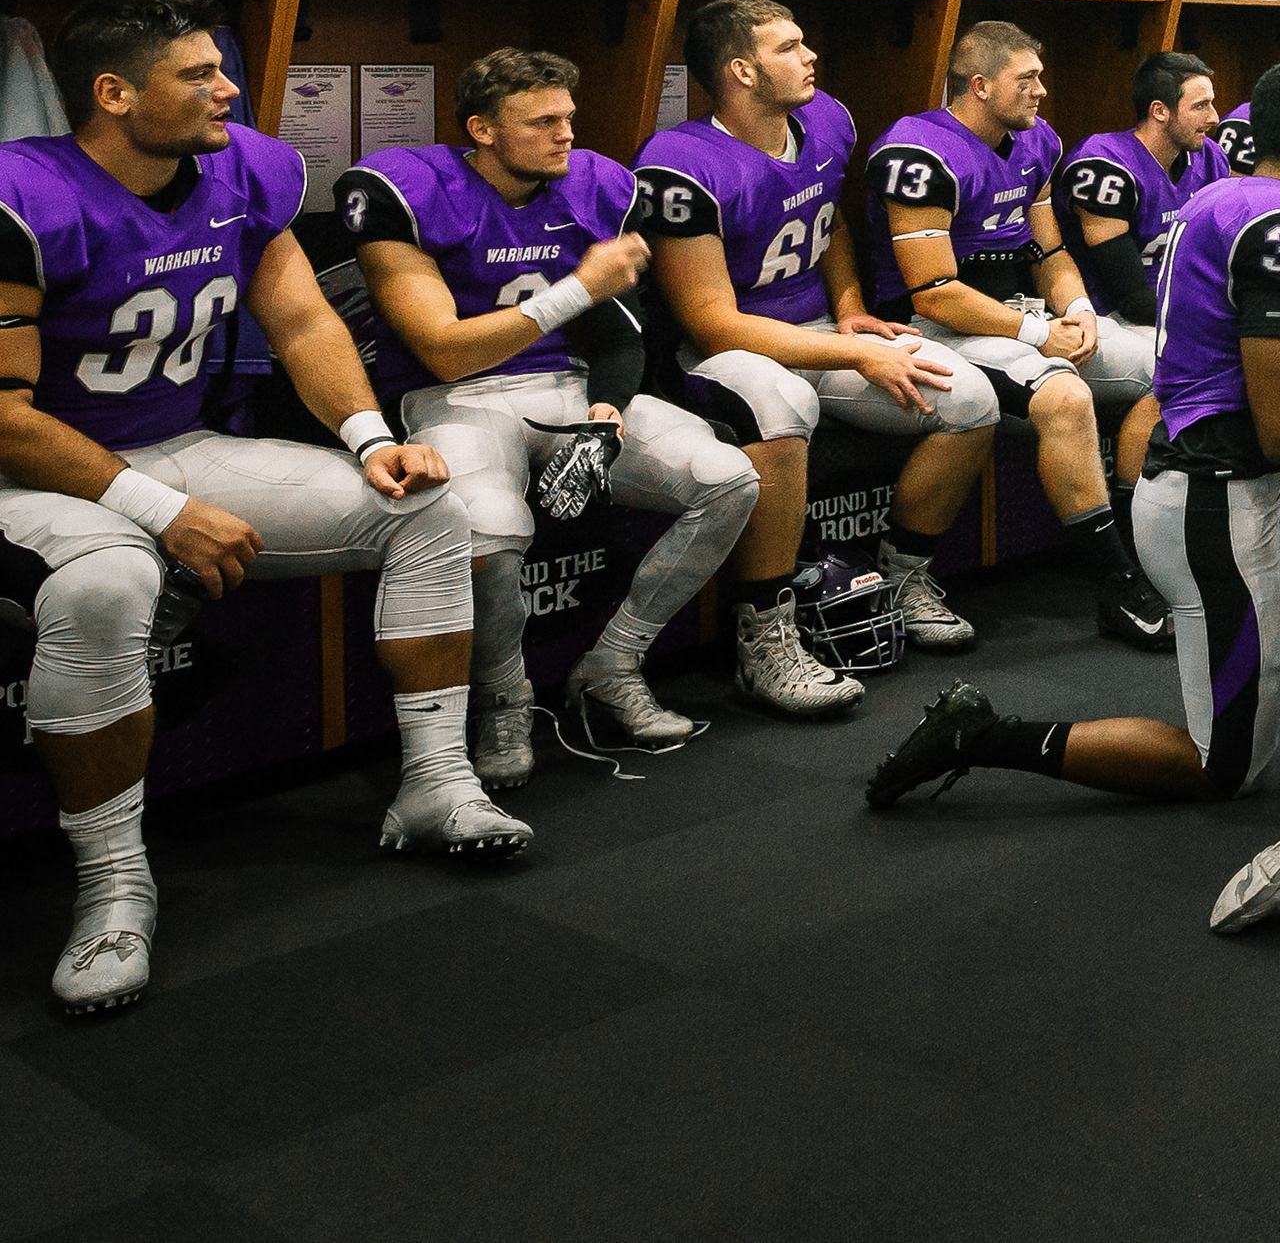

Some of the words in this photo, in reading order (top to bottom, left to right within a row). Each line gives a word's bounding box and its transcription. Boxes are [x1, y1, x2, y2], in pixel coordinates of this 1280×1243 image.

[1219, 127, 1256, 165] 62
[884, 158, 933, 199] 13
[1072, 167, 1126, 206] 26
[782, 182, 823, 212] WARHAWKS
[144, 245, 223, 276] WARHAWKS
[486, 245, 561, 264] WARHAWKS
[820, 507, 891, 541] ROCK
[555, 547, 606, 579] THE
[150, 642, 193, 676] HE
